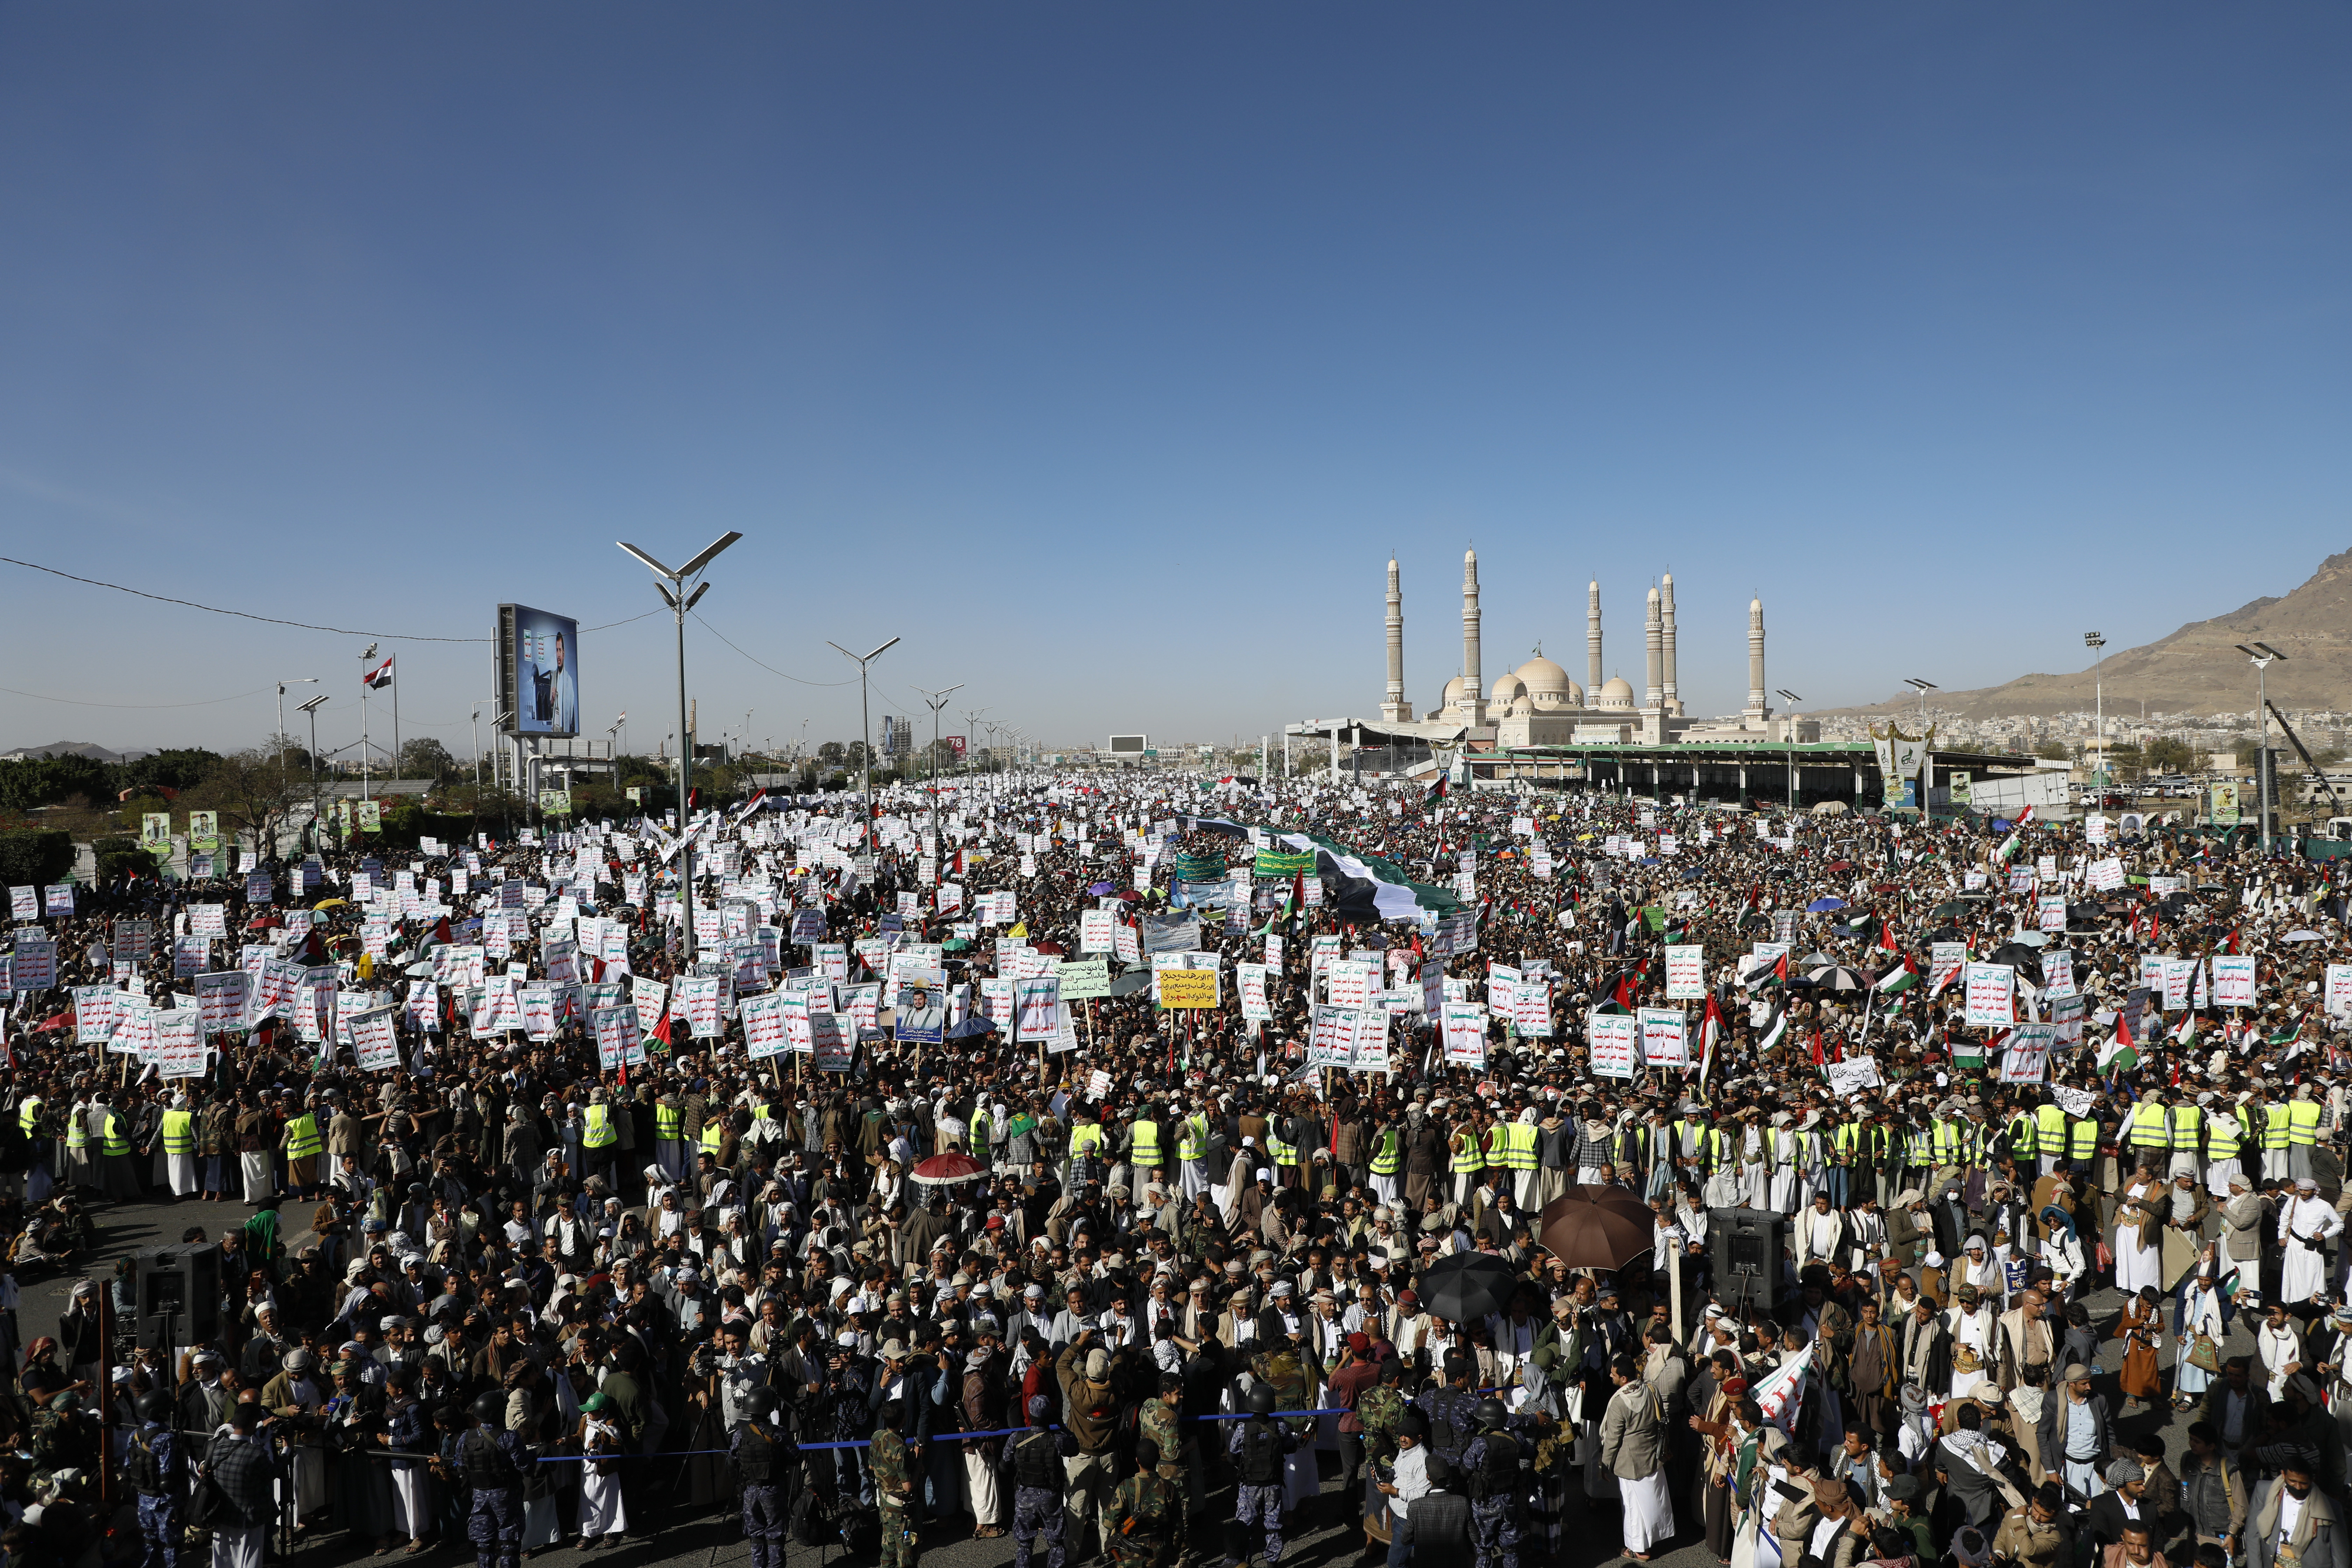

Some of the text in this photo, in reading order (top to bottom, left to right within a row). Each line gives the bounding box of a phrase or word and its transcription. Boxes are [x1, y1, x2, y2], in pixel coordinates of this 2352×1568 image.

[949, 738, 963, 747] 78
[2217, 962, 2250, 972] قاطعوا
[1971, 970, 2009, 982] الله أكبر
[2218, 973, 2250, 983] البضائع الأمريكية
[1020, 983, 1054, 997] قاطعوا
[1079, 982, 1097, 992] الشعب
[1971, 982, 1991, 991] لأمريكا
[1971, 993, 1990, 1001] لإسرائيل
[2218, 992, 2251, 1001] الإسرائيلية
[1021, 998, 1054, 1010] البضائع الأمريكية
[599, 1010, 634, 1025] الله أكبر
[1319, 1009, 1357, 1021] الله أكبر
[1970, 1012, 2009, 1023] النصر للإسلام
[161, 1015, 188, 1031] أكبر
[600, 1021, 636, 1032] الموت لأمريكا
[1594, 1018, 1630, 1031] الله أكبر
[1644, 1015, 1681, 1027] قاطعوا
[161, 1029, 198, 1038] الموت لأمريكا
[1021, 1022, 1056, 1034] الإسرائيلية
[602, 1031, 637, 1044] الموت لإسرائيل
[1316, 1031, 1352, 1042] الموت لإسرائيل
[1594, 1031, 1613, 1039] لأمريكا
[1645, 1028, 1681, 1041] البضائع الأمريكية
[162, 1041, 199, 1049] الموت لإسرائيل
[603, 1044, 616, 1053] اليهود
[1594, 1042, 1613, 1051] لإسرائيل
[625, 1049, 640, 1061] النصر
[1314, 1050, 1350, 1062] النصر للإسلام
[1646, 1051, 1683, 1061] الإسرائيلية
[163, 1061, 202, 1072] النصر للإسلام
[1592, 1061, 1630, 1072] النصر للإسلام
[2066, 1091, 2093, 1101] البحر
